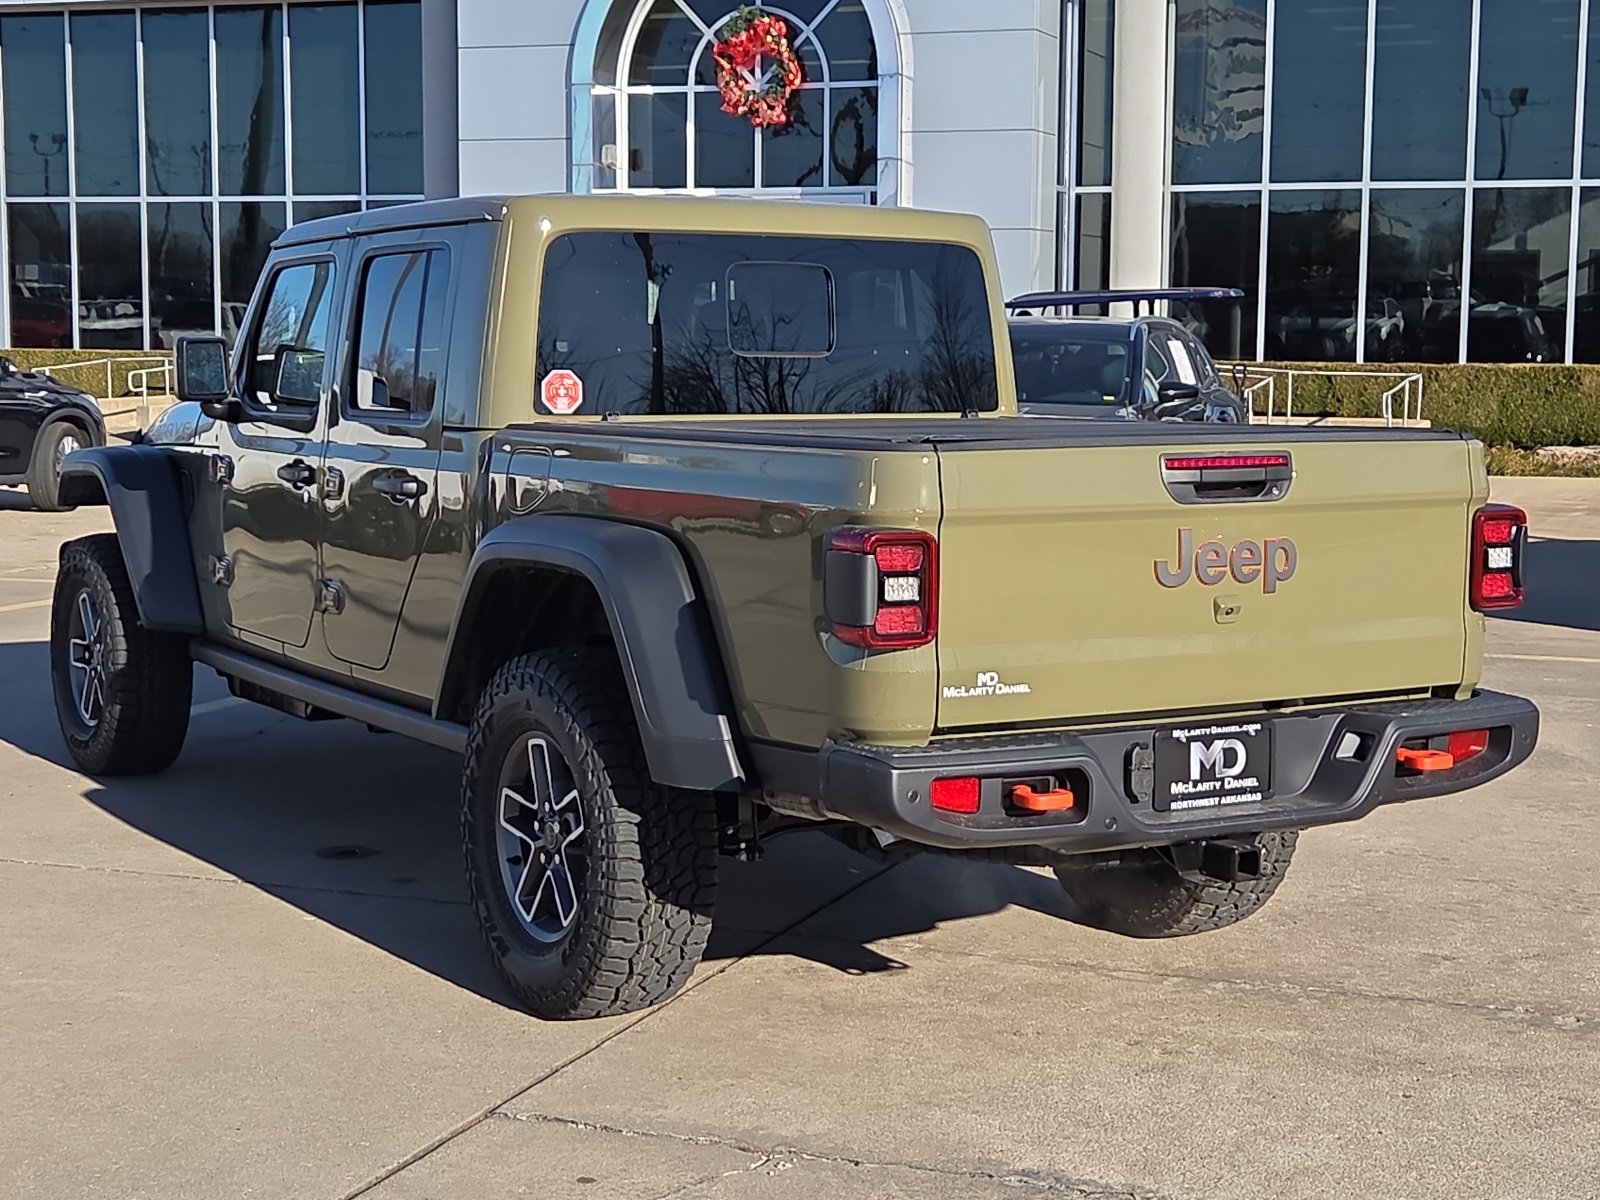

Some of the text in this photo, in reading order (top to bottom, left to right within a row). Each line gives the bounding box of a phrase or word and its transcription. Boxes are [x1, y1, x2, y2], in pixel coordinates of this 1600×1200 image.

[1154, 528, 1297, 594] Jeep
[977, 672, 999, 686] MD
[995, 683, 1031, 695] DANIEL
[1190, 738, 1247, 780] MD
[1224, 777, 1259, 790] DANIEL
[1170, 792, 1262, 810] NORTHWEST ARKANSAS
